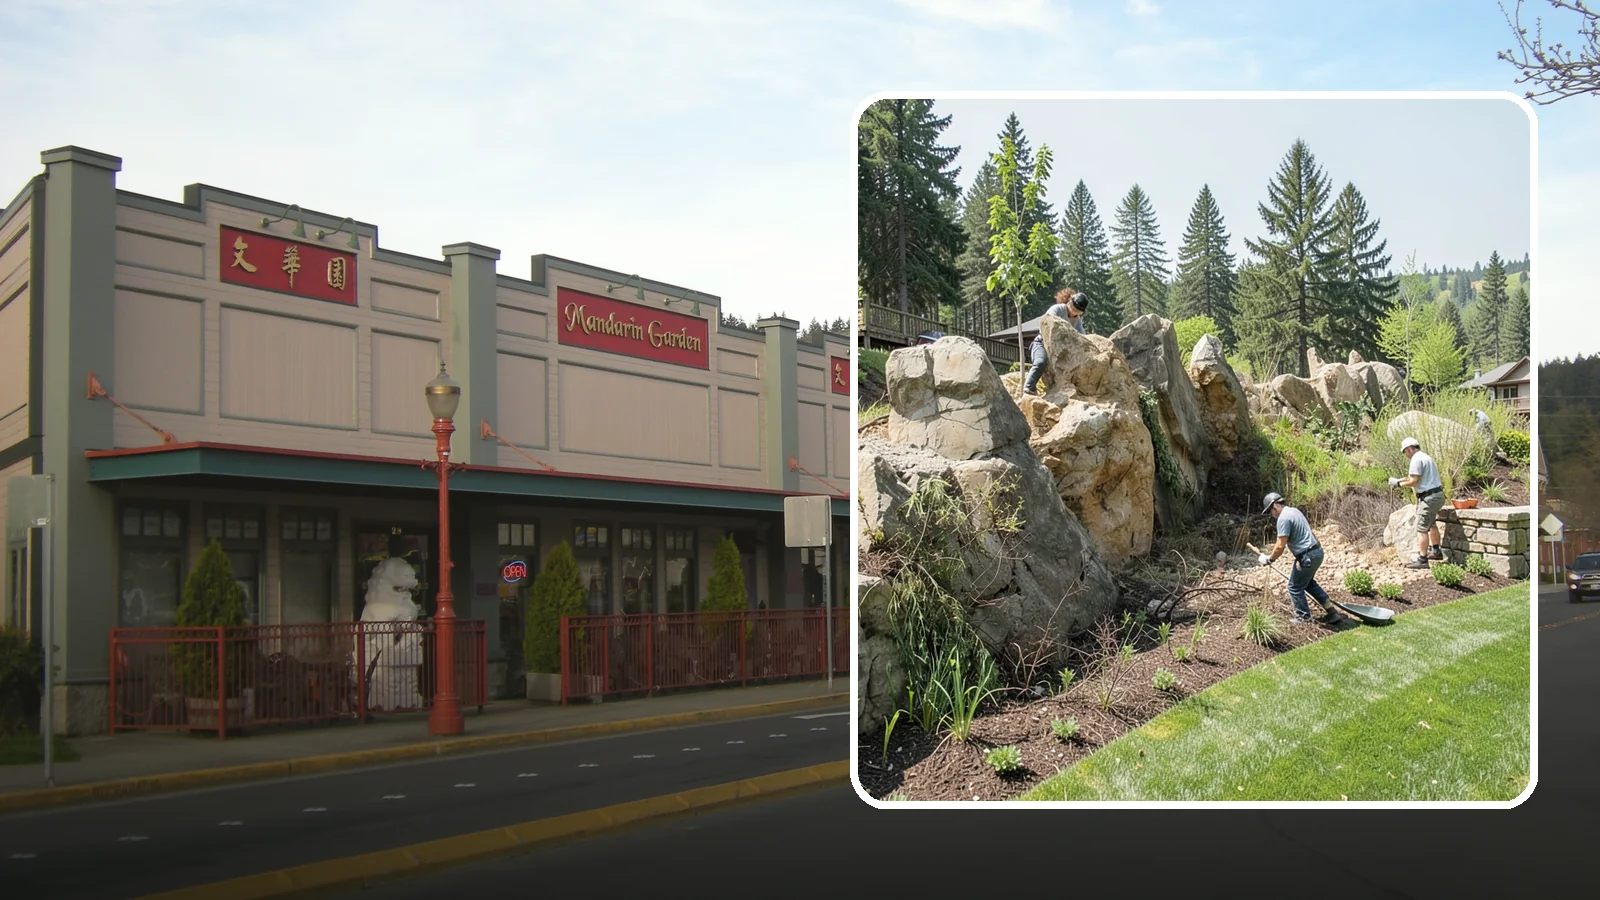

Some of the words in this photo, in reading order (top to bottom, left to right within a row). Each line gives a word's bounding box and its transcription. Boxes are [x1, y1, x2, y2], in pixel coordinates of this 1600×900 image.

[231, 236, 346, 291] 文華園
[564, 302, 644, 341] Mandarin
[648, 320, 702, 352] Garden
[503, 565, 526, 578] OPEN
